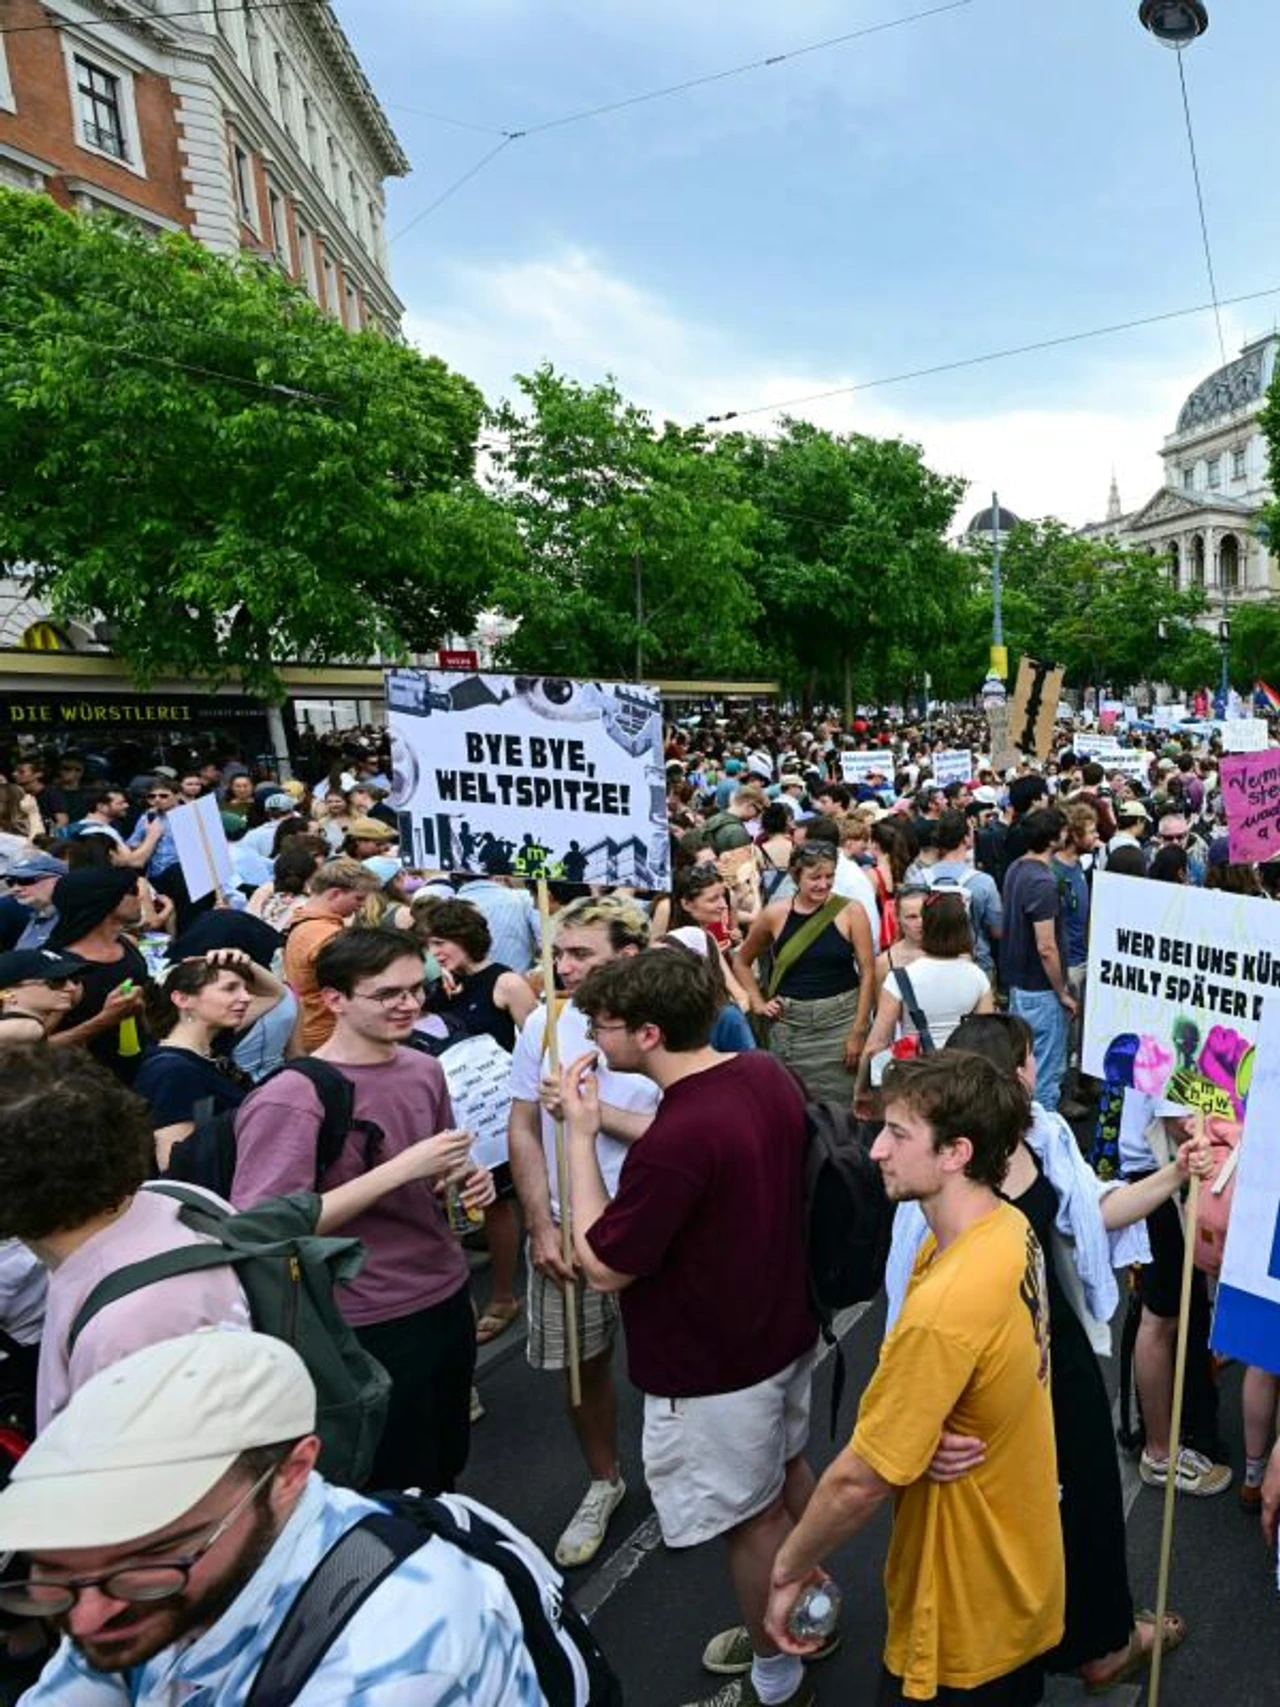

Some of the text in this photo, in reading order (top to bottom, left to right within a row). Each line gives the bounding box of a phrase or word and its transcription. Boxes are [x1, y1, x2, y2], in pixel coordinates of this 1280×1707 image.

[10, 705, 50, 721] DIE
[61, 702, 190, 721] WÜRSTLEREI
[465, 732, 595, 778] BYE BYE,
[435, 769, 630, 815] WELTSPITZE!
[1117, 928, 1155, 959] WER
[1159, 937, 1192, 968] BEI
[1197, 945, 1237, 976] UNS
[1101, 961, 1161, 997] ZAHLT
[1165, 975, 1247, 1018] SPÄTER
